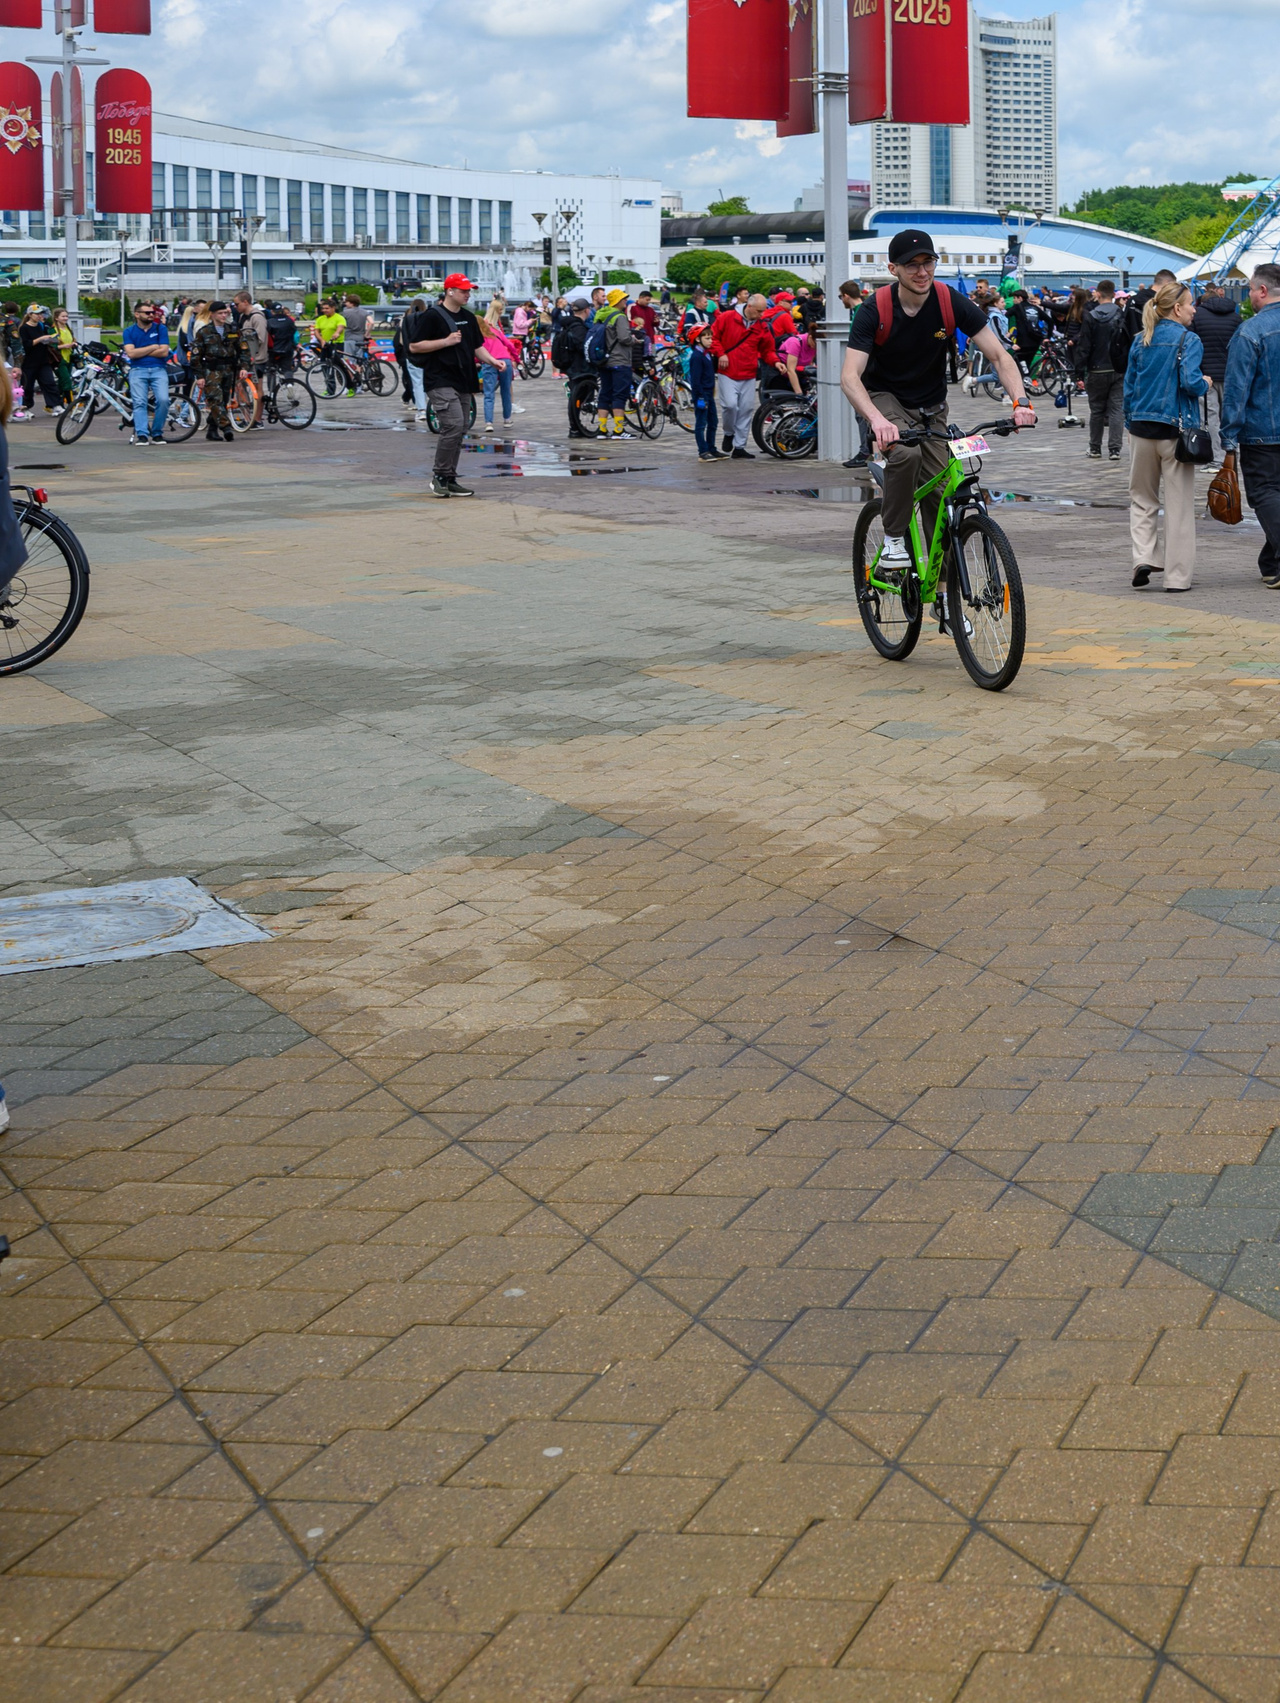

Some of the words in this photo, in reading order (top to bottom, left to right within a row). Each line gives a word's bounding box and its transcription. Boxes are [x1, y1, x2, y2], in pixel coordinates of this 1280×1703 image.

[893, 0, 951, 26] 2025
[97, 100, 151, 126] Победа
[107, 128, 142, 145] 1945
[106, 148, 142, 165] 2025
